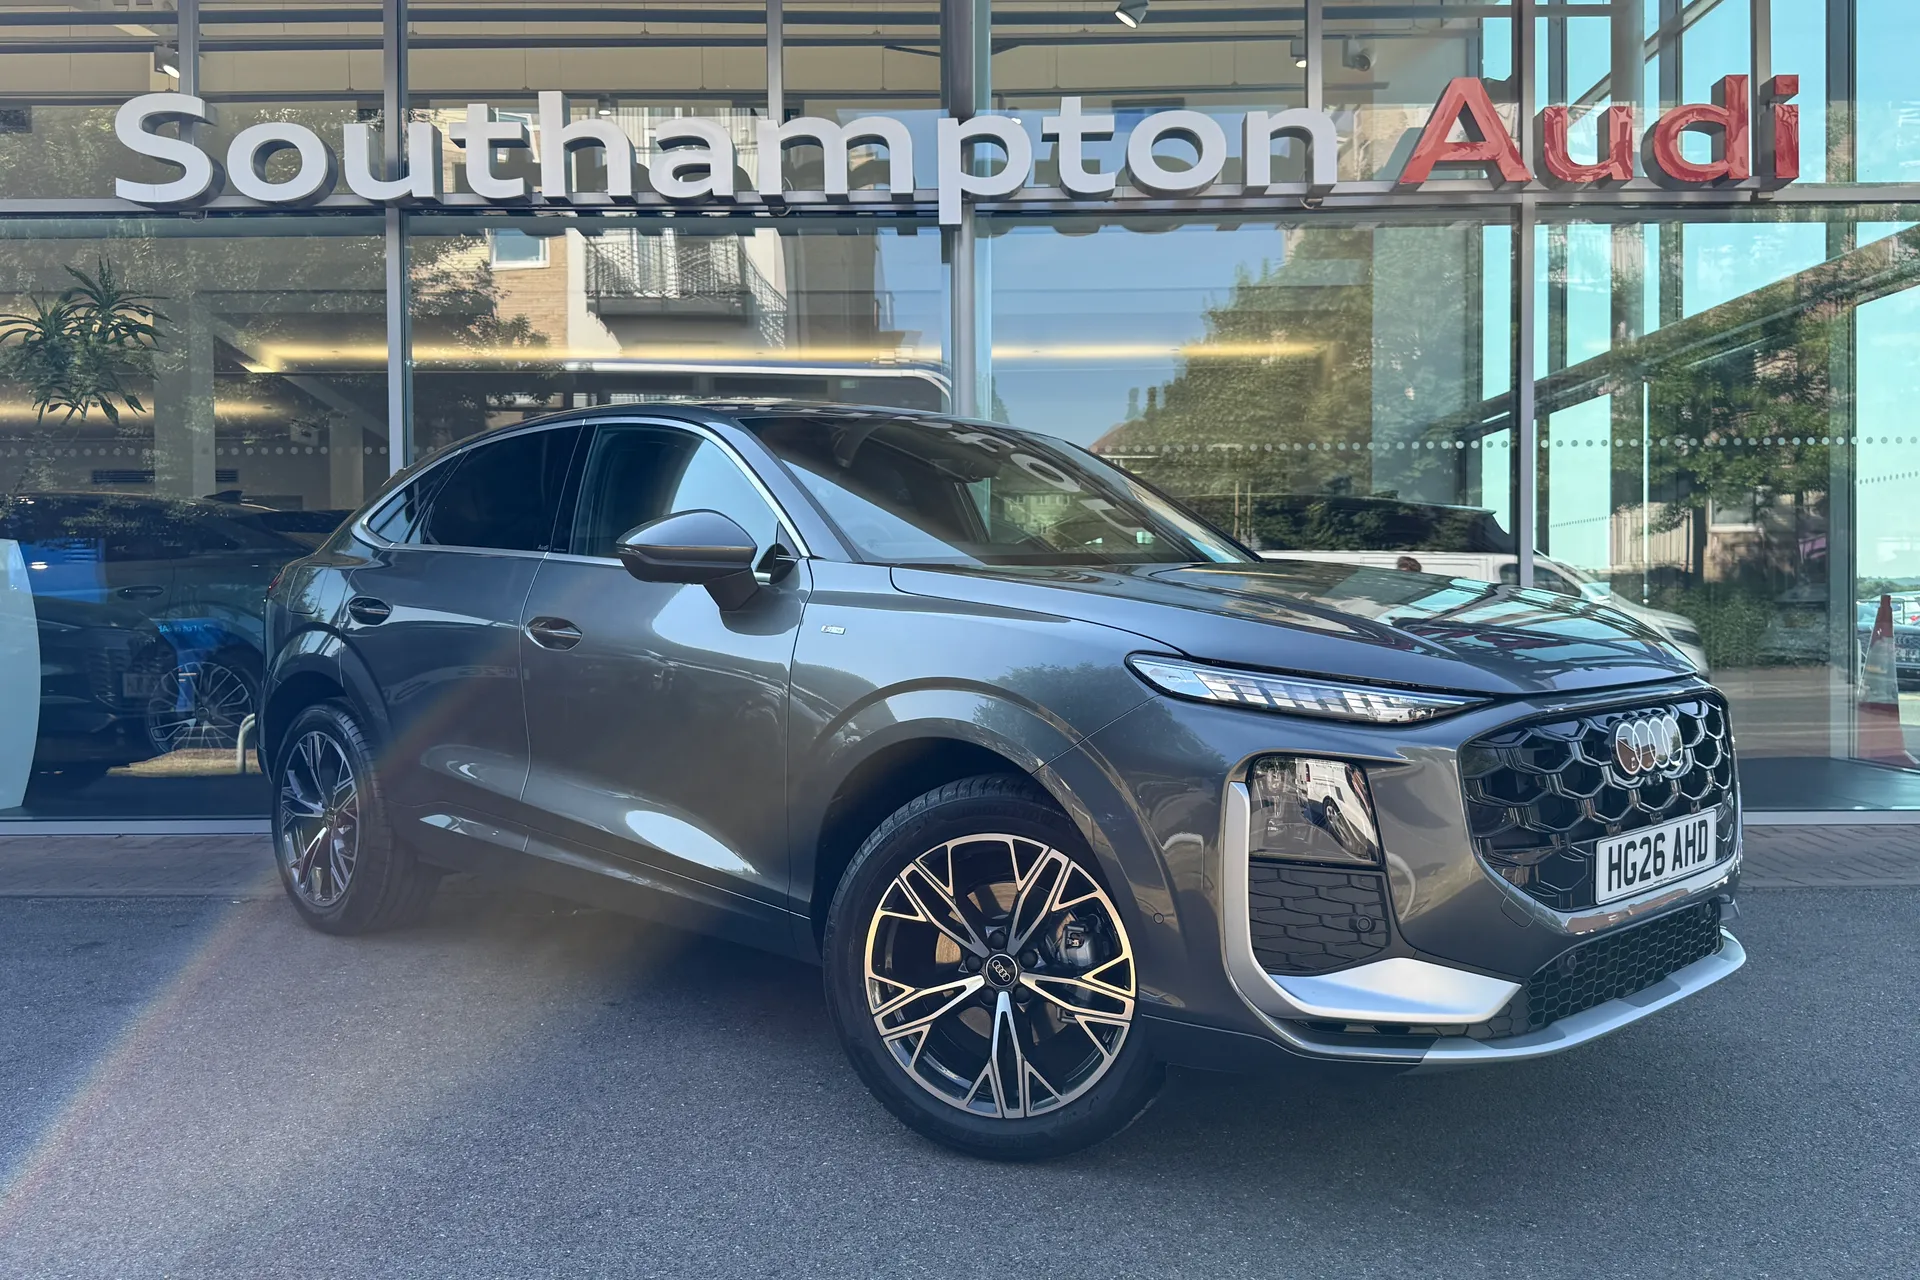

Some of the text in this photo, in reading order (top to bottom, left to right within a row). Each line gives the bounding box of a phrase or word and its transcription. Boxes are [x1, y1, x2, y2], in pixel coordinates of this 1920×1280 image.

[114, 74, 1801, 226] Southampton Audi
[1607, 818, 1709, 892] HG26 AHD
